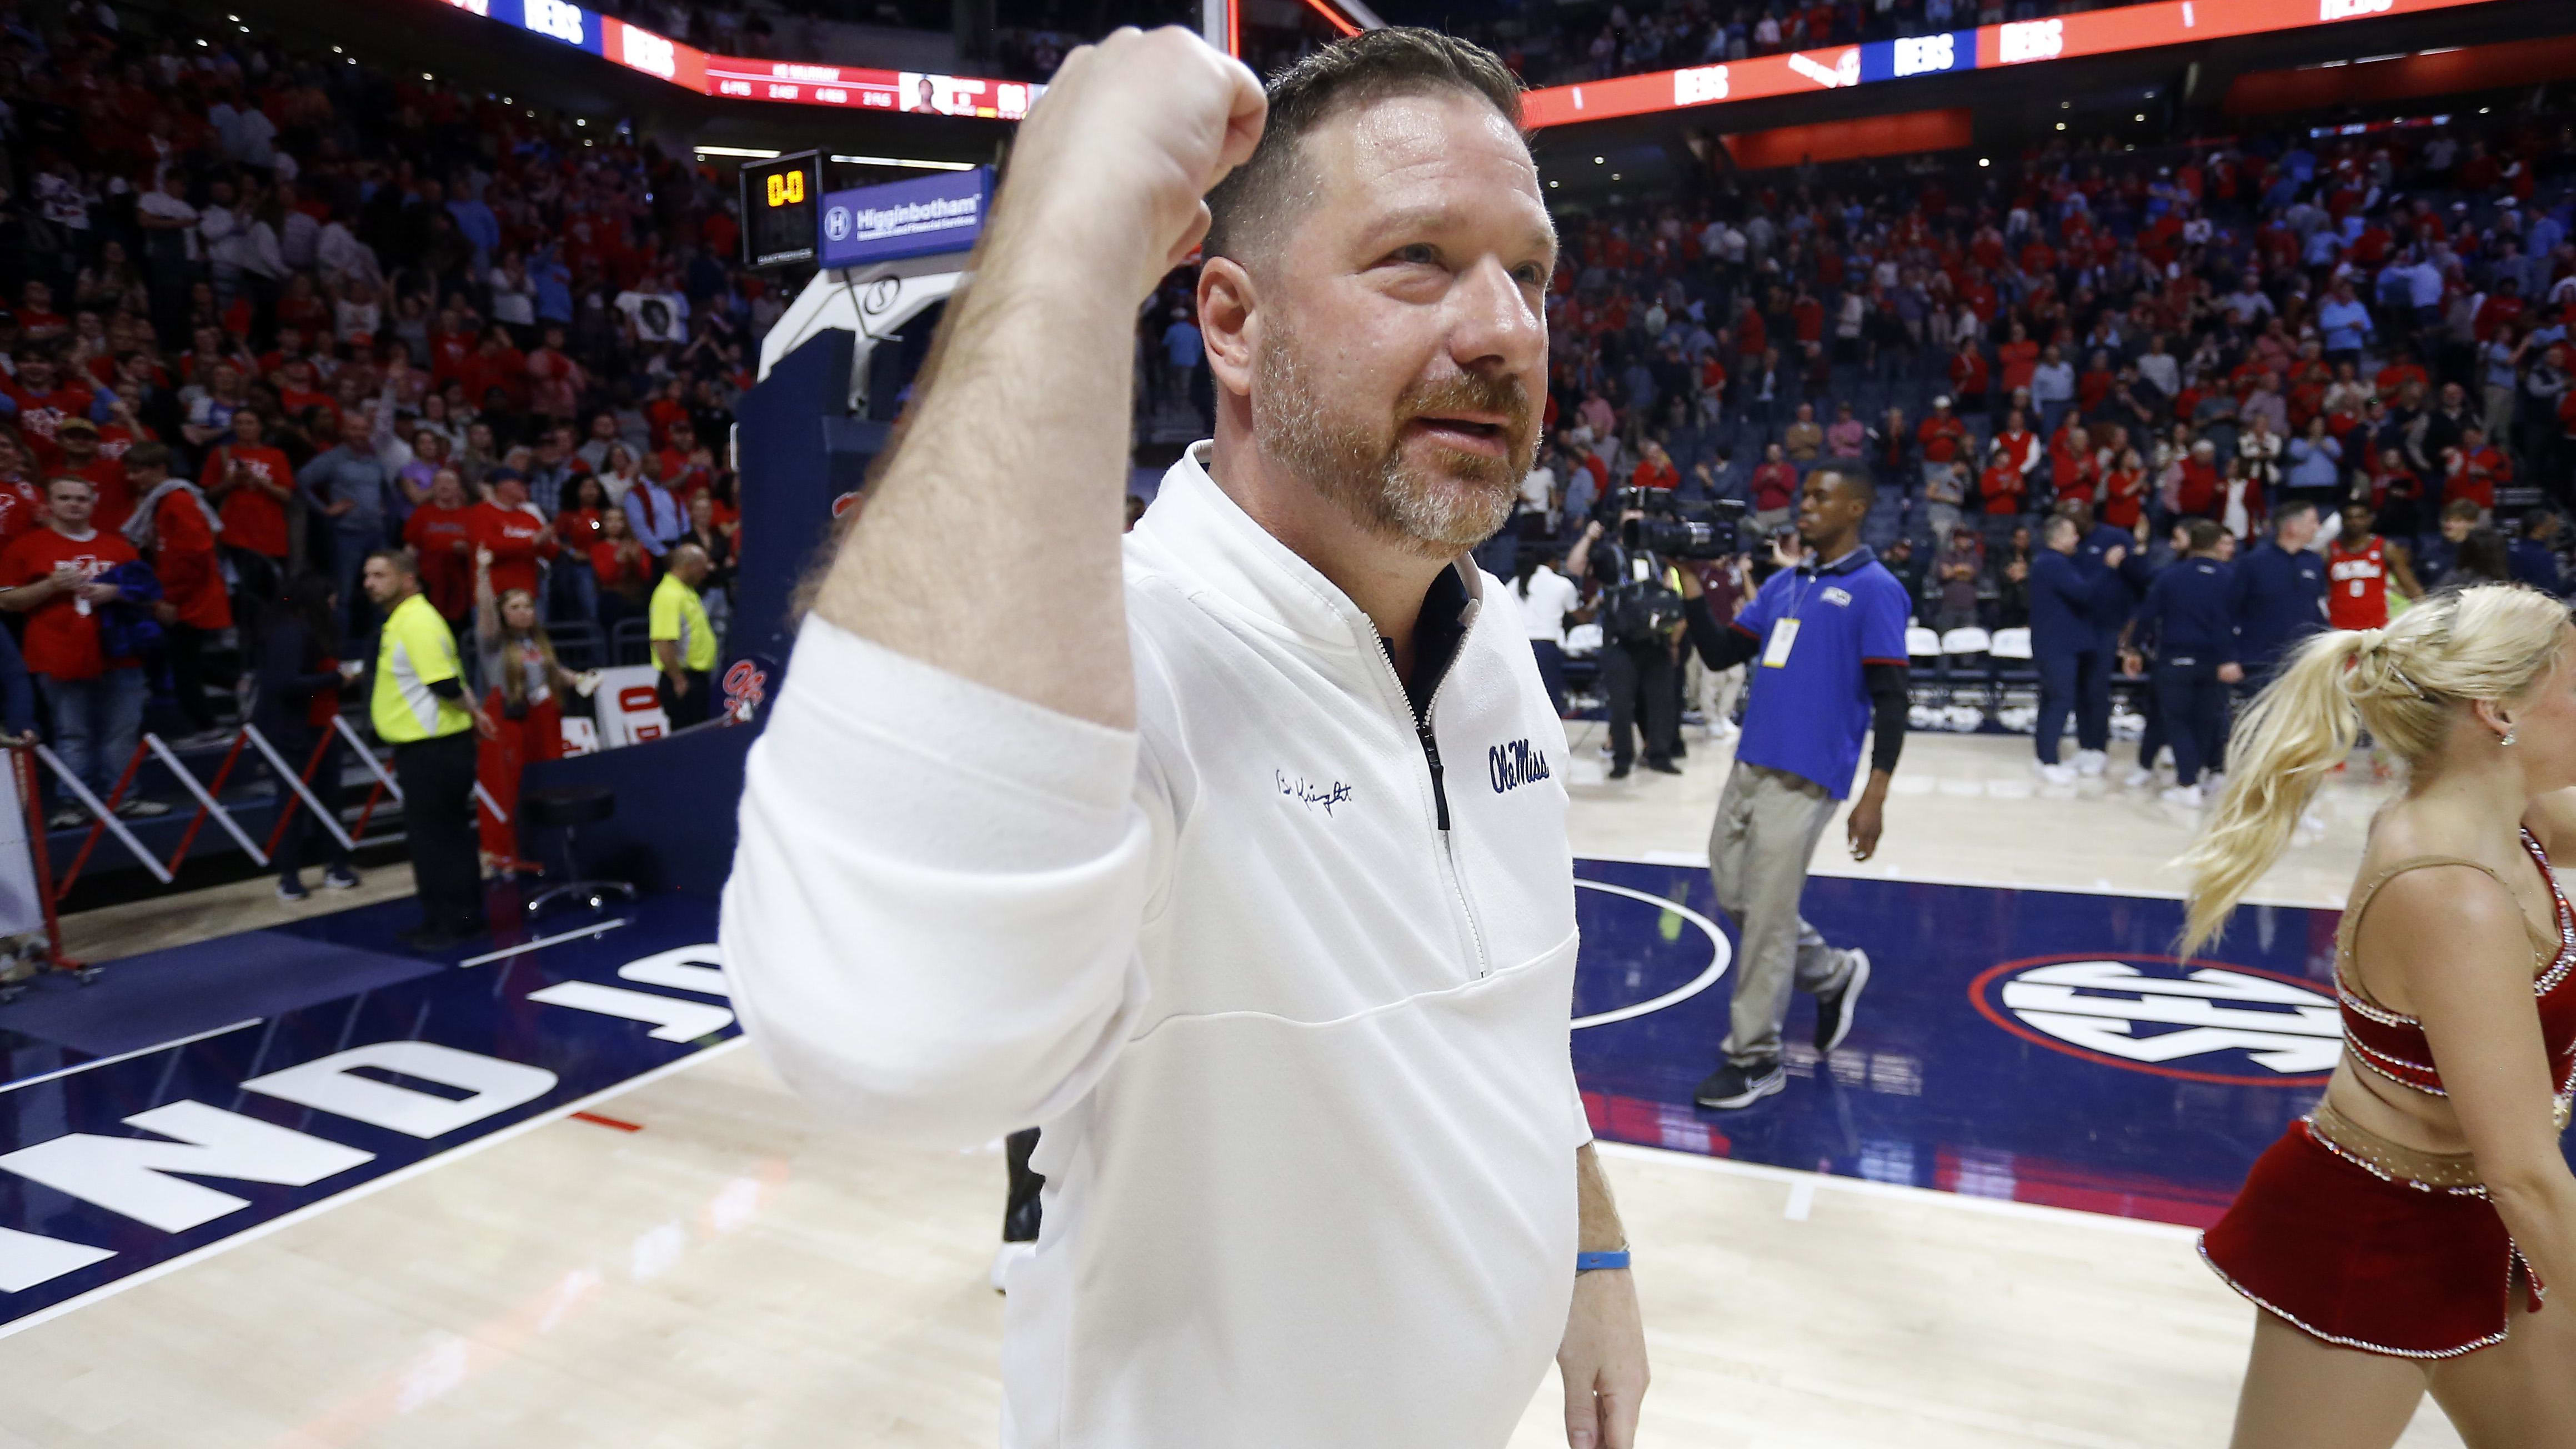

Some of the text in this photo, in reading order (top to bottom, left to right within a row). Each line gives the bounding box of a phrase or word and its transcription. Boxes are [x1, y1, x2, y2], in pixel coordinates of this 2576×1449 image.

[622, 24, 675, 78] REBS
[1894, 33, 1955, 77] REBS
[2000, 19, 2063, 63] REBS
[1673, 64, 1729, 106] REBS
[857, 197, 978, 229] Higginbotham
[1489, 738, 1550, 794] Ole Miss
